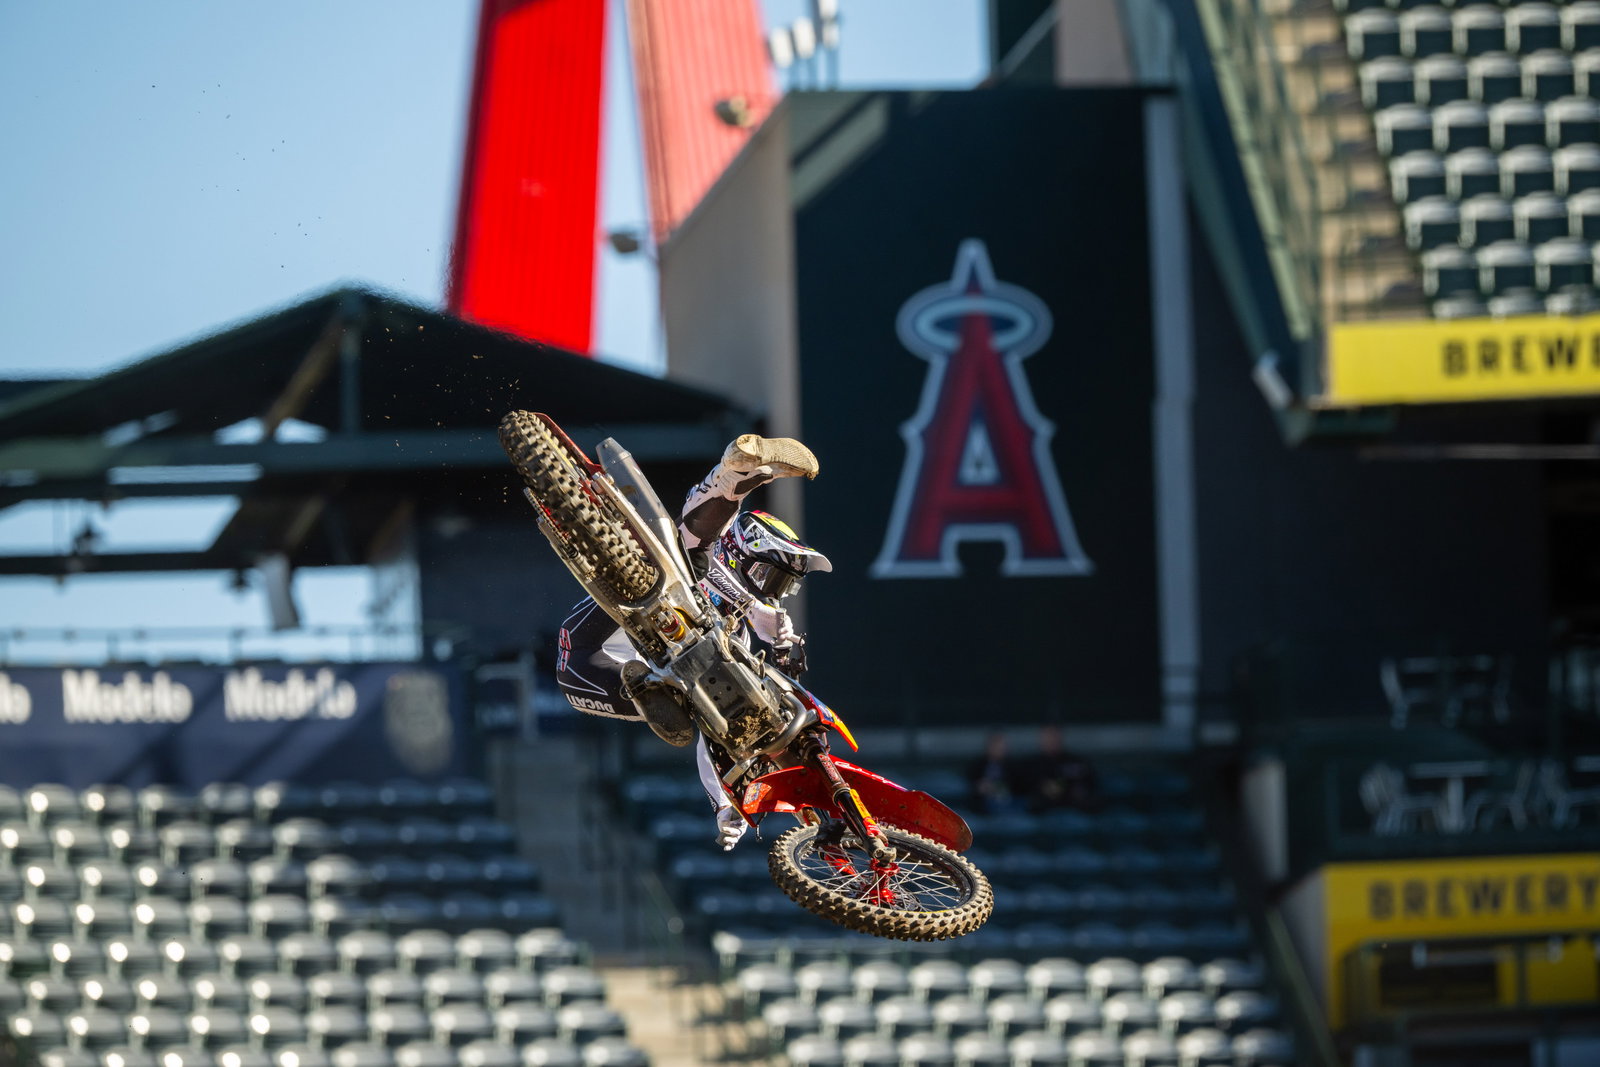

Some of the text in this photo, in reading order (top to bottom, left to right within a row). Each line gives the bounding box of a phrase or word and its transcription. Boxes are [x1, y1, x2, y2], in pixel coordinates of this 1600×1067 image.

[706, 567, 745, 603] Designs
[62, 668, 194, 725] Modelo
[223, 666, 358, 722] Modelo
[565, 693, 616, 714] DUCATI
[1367, 870, 1600, 922] BREWERY
